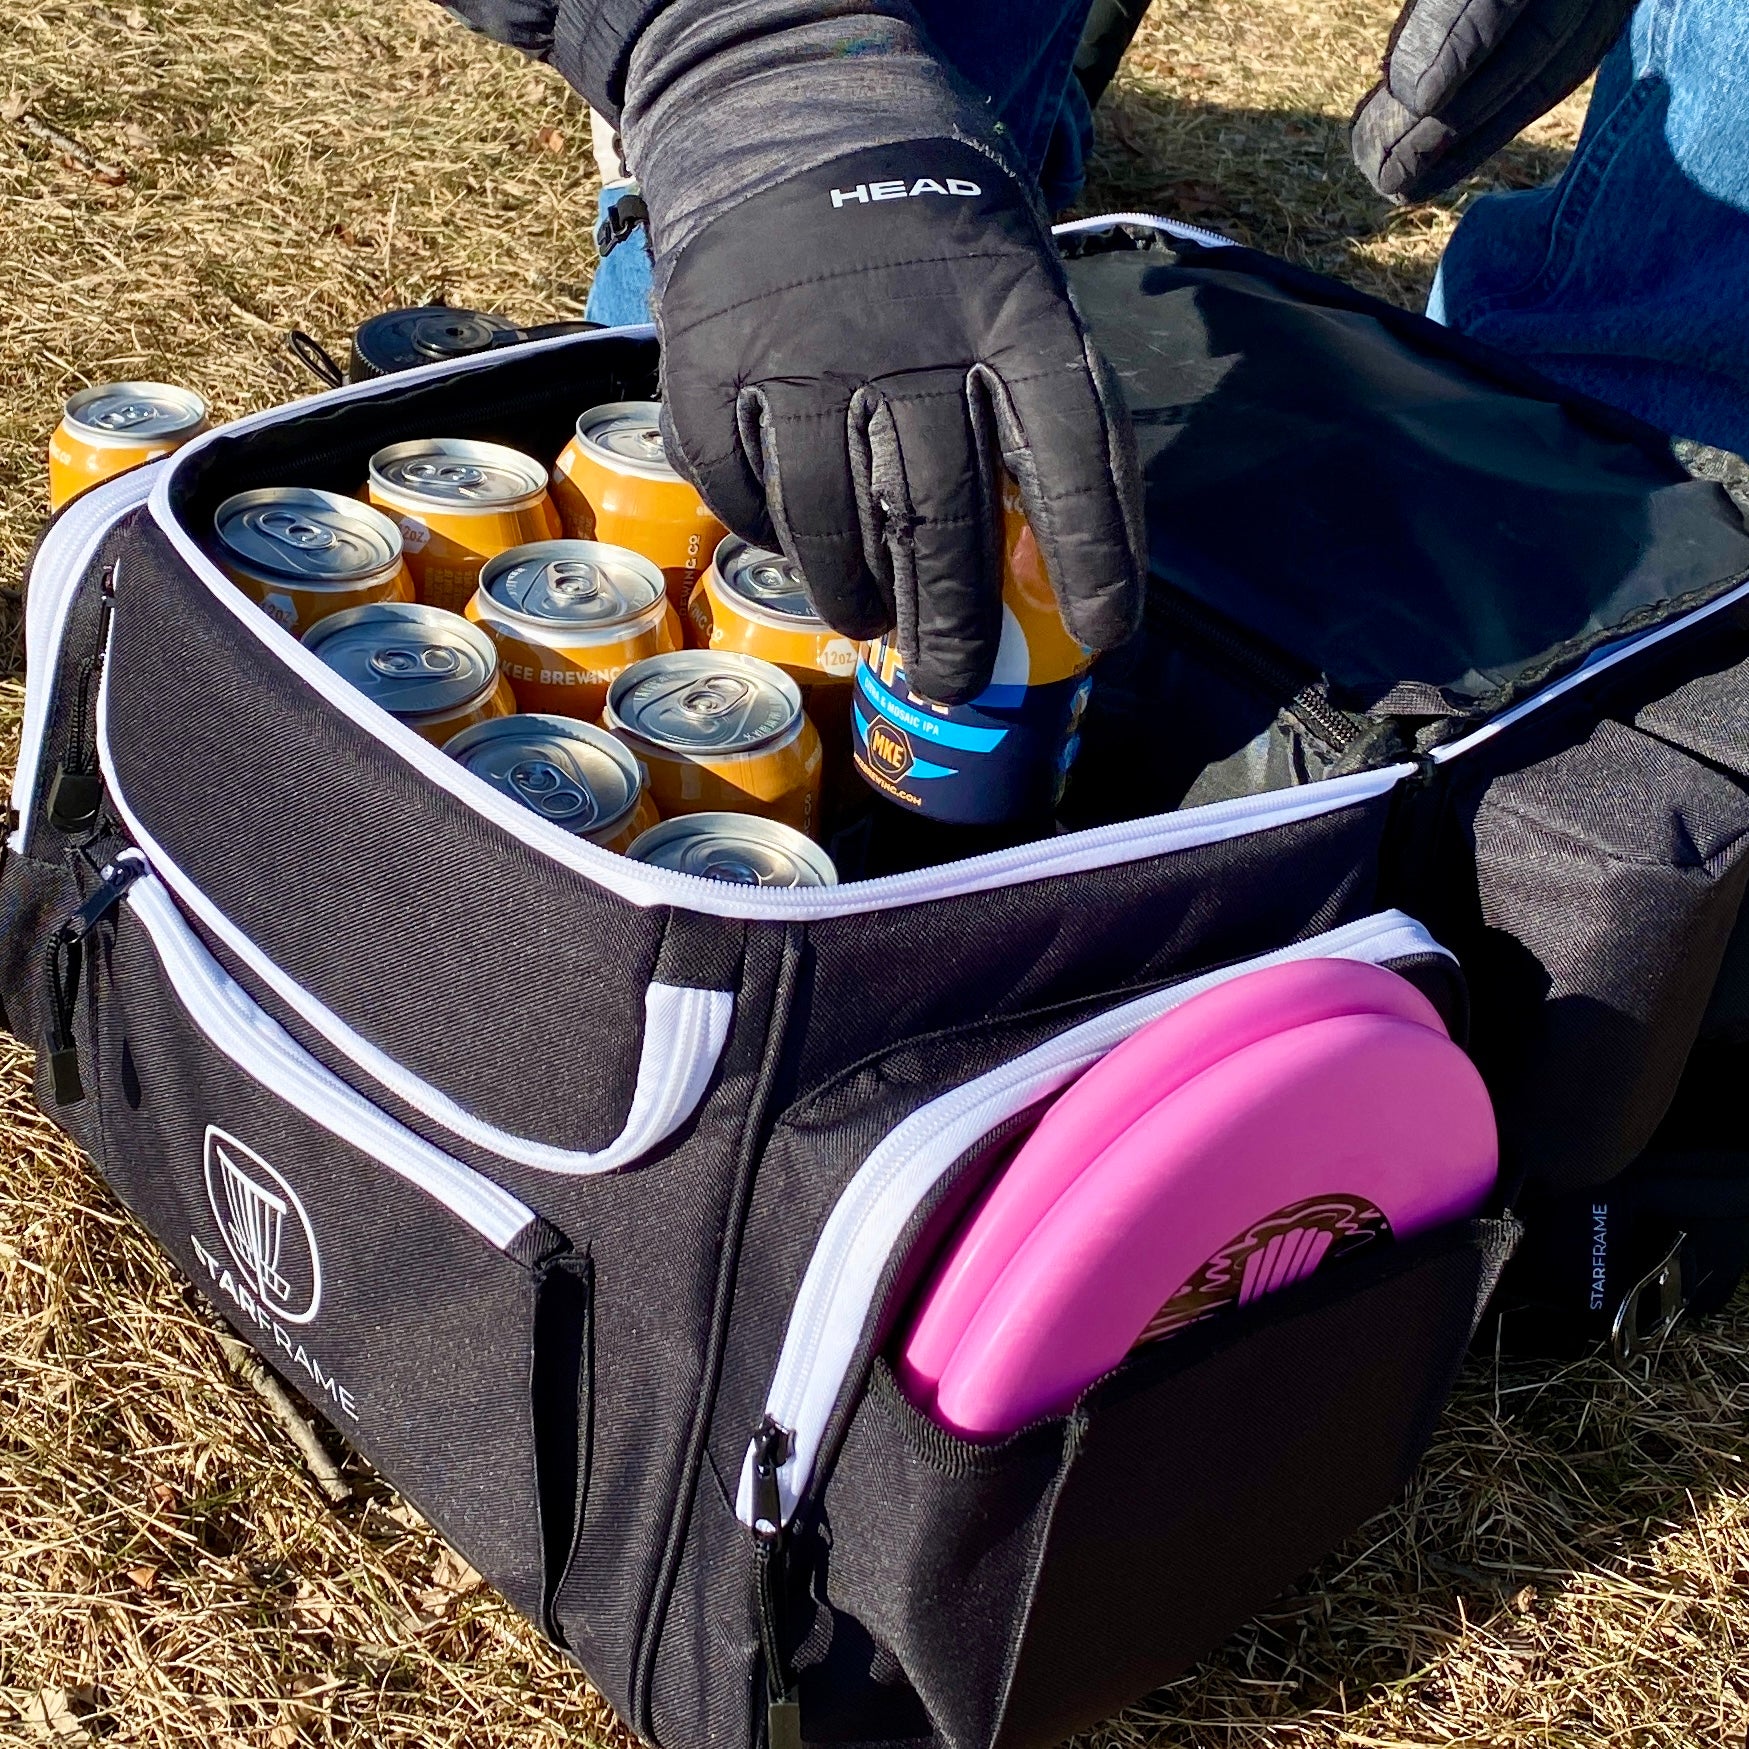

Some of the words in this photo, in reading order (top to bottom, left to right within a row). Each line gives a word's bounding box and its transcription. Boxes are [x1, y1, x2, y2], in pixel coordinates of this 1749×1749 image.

[830, 178, 982, 208] HEAD
[540, 666, 622, 686] BREWING
[887, 703, 920, 728] MOSAIC
[922, 720, 939, 737] IPA
[872, 729, 904, 769] MKE
[1590, 1203, 1608, 1310] STARFRAME
[190, 1234, 359, 1421] STARFRAME
